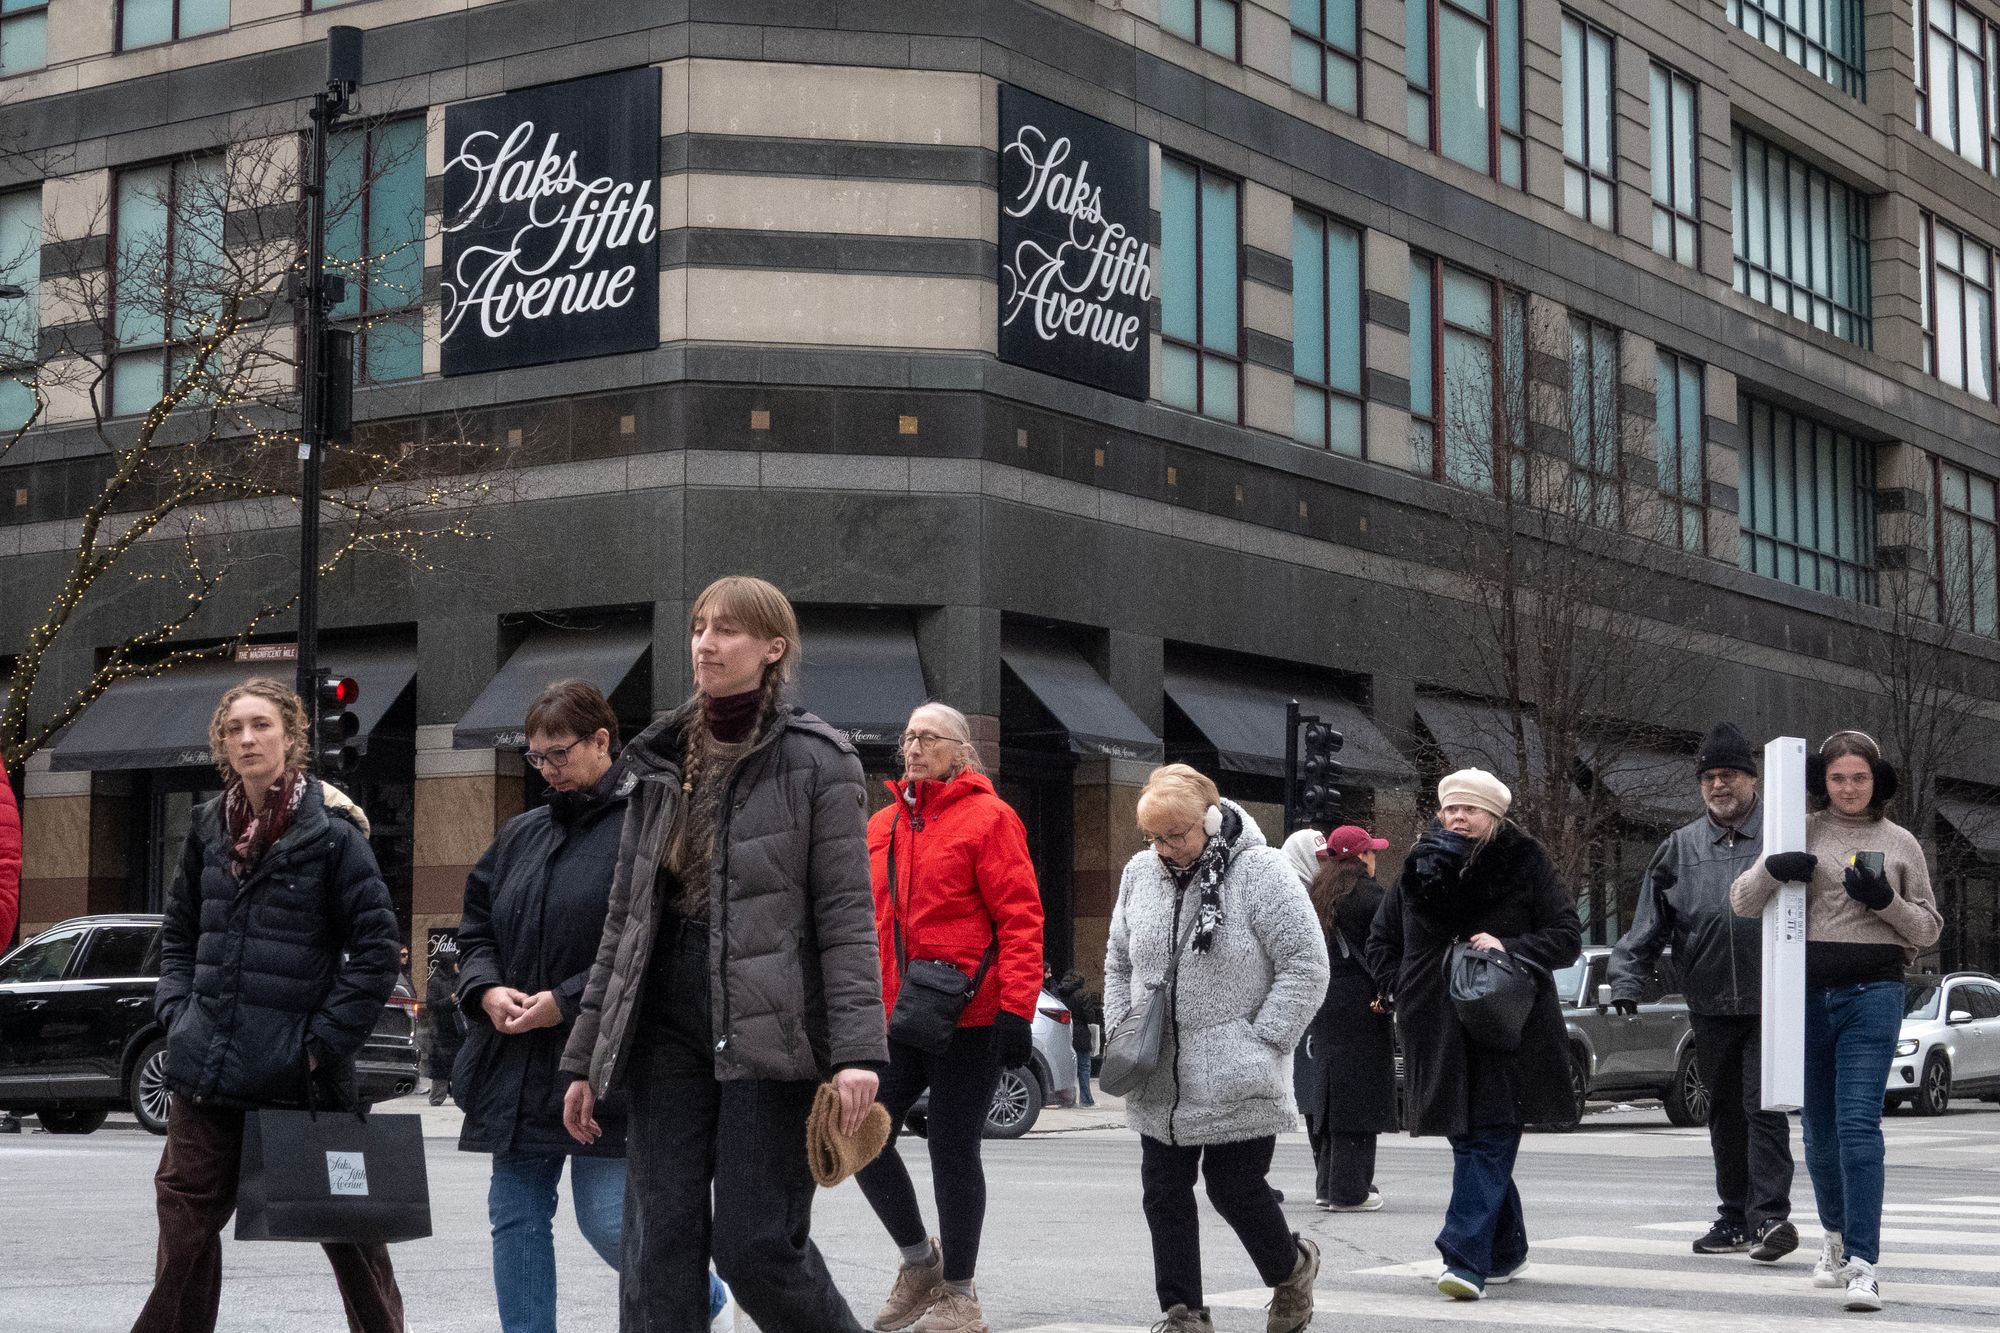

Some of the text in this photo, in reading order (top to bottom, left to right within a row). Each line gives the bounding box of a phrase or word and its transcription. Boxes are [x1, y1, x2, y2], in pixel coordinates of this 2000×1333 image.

[441, 121, 579, 233] Saks
[1003, 125, 1102, 224] Saks
[511, 177, 657, 277] Fifth
[1057, 207, 1152, 302] Fifth
[440, 245, 636, 345] Avenue
[1003, 240, 1140, 352] Avenue
[238, 651, 249, 660] THE
[249, 649, 282, 659] MAGNIFICENT
[283, 648, 296, 657] MILE
[850, 728, 881, 743] Avenue
[427, 934, 458, 957] Saks
[328, 1156, 352, 1172] Saks
[331, 1175, 363, 1190] Avenue
